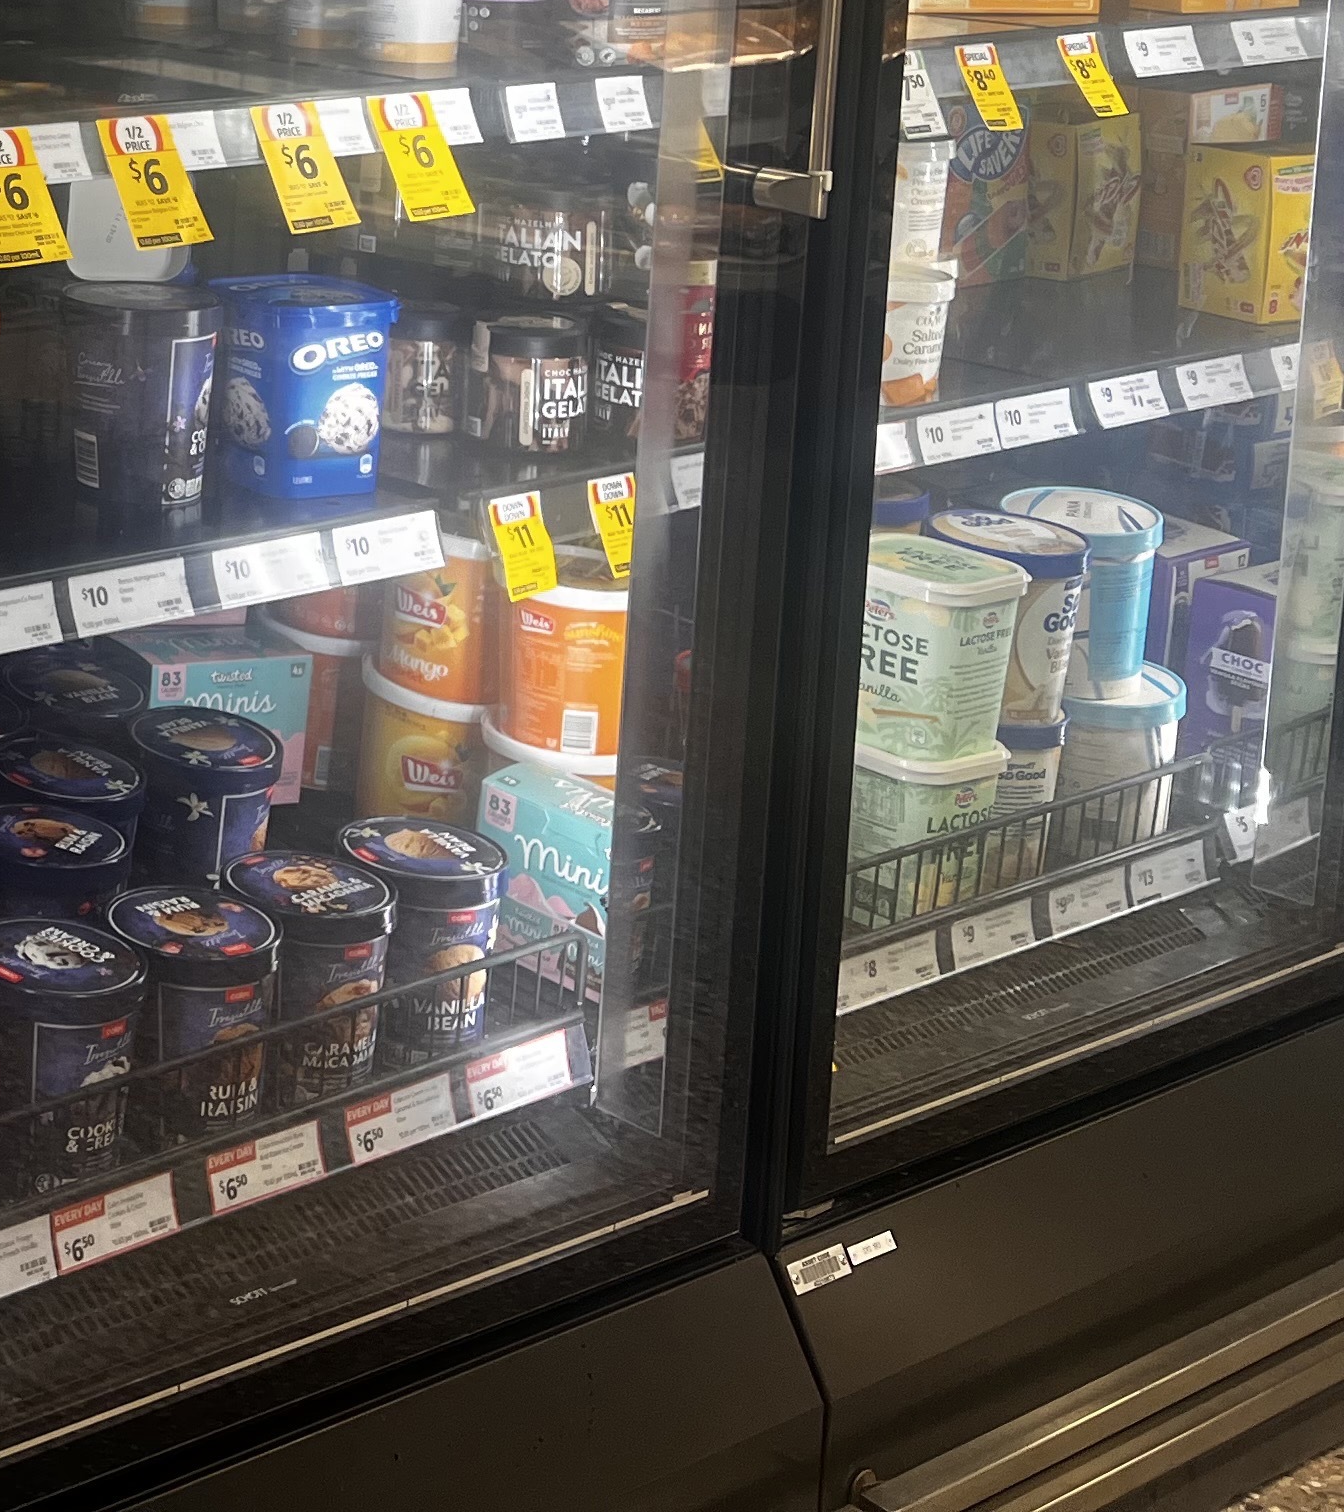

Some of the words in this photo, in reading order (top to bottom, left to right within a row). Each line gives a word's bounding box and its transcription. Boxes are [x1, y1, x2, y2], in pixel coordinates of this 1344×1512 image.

[125, 125, 145, 139] 1/2
[124, 137, 153, 151] PRICE
[290, 329, 384, 372] OREO
[385, 652, 449, 680] Mango
[1220, 651, 1263, 674] CHOC
[160, 671, 183, 685] 83
[211, 669, 252, 683] twisted
[407, 760, 457, 785] Weis
